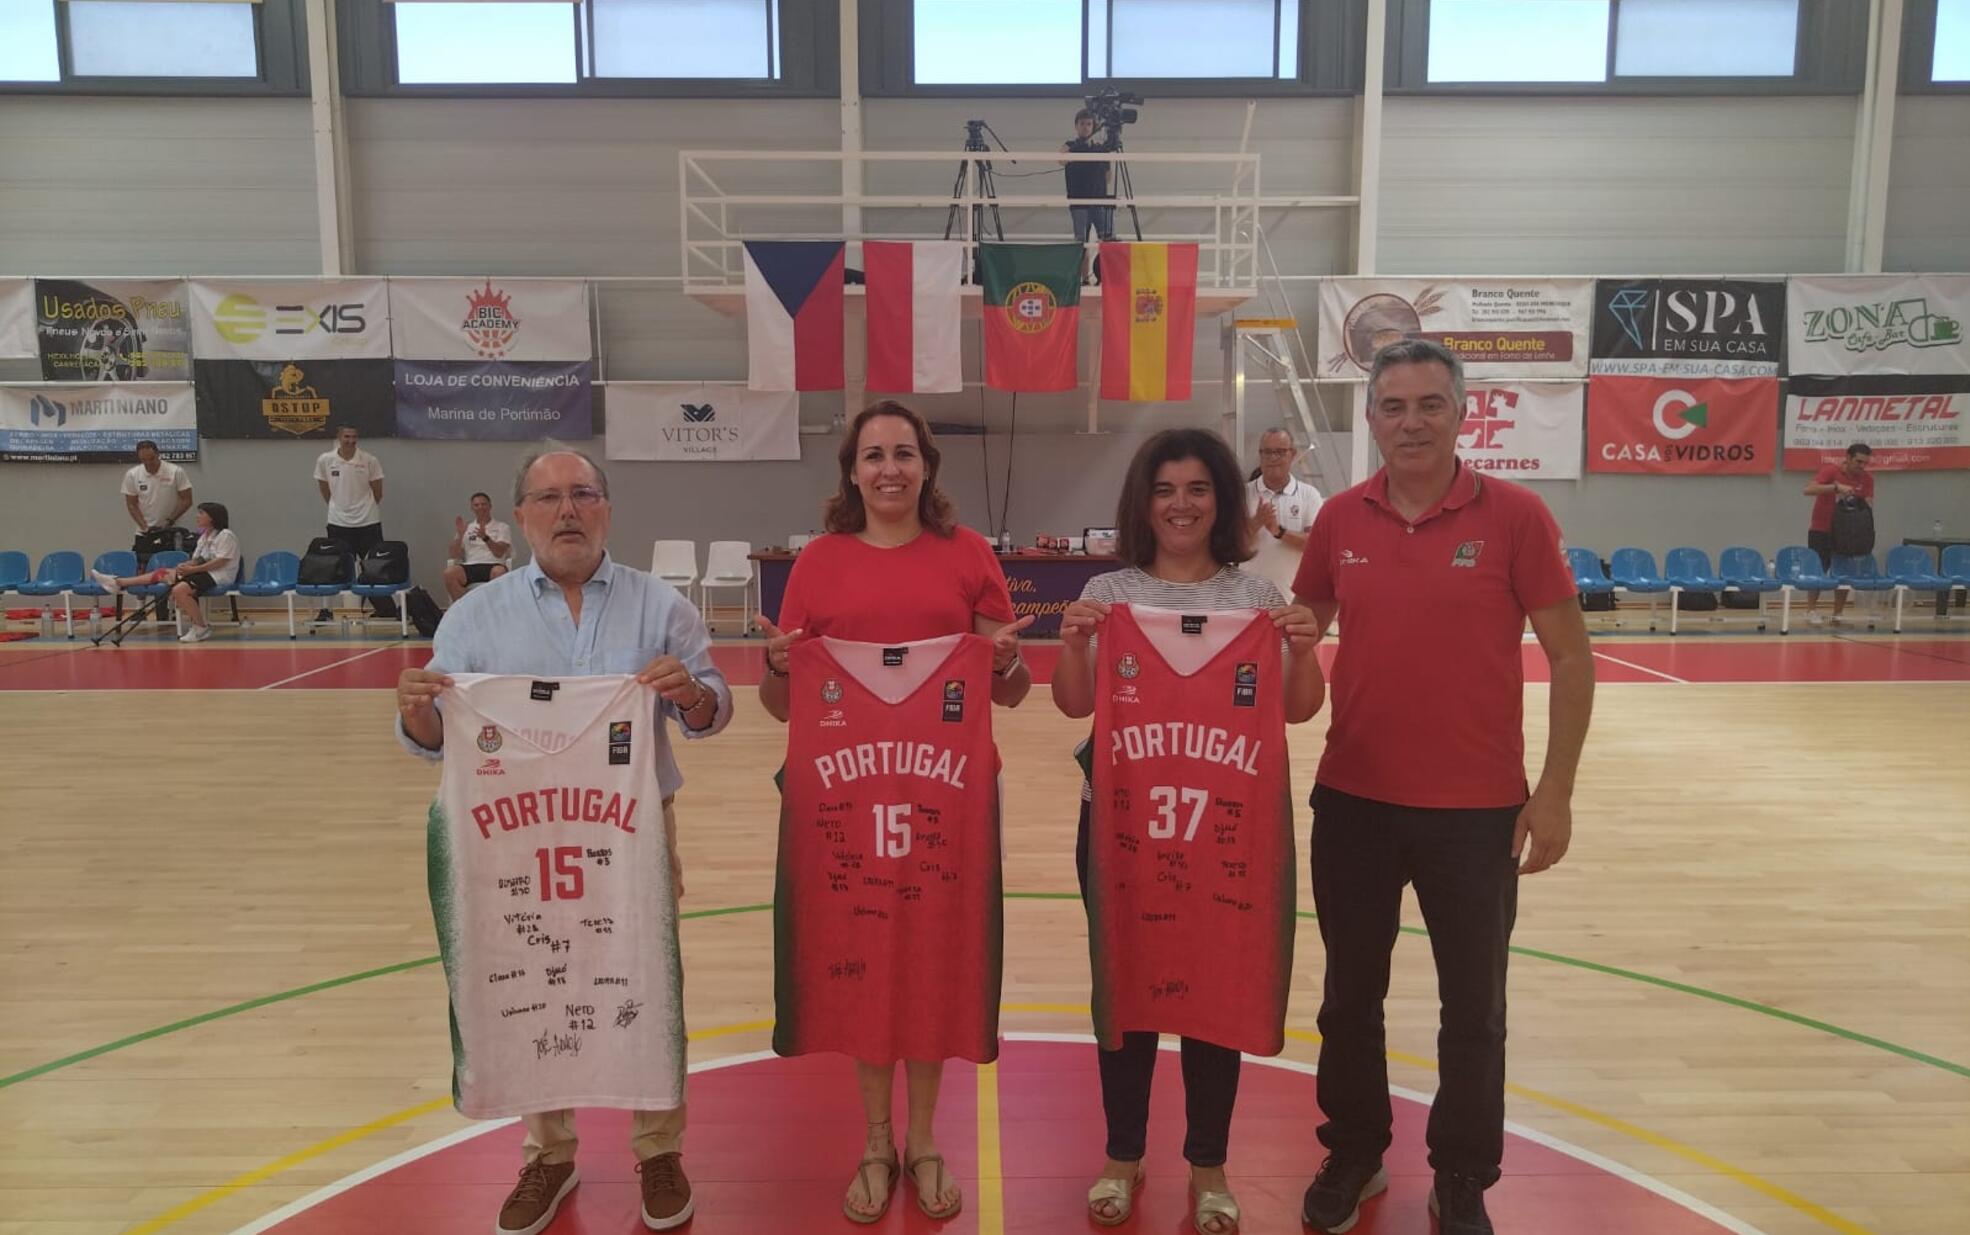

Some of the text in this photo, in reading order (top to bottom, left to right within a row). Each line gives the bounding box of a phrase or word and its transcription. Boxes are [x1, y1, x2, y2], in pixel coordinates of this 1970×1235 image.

[1471, 288, 1541, 300] Branco Quente
[43, 295, 182, 320] Usados Pneu
[1665, 290, 1769, 335] SPA
[275, 303, 367, 334] EXIS
[462, 319, 520, 329] ACADEMY
[1803, 302, 1909, 338] ZONA
[1443, 336, 1547, 352] Branco Quente
[1664, 339, 1767, 354] EM SUA CASA
[404, 373, 444, 386] LOJA
[447, 374, 468, 387] DE
[70, 398, 168, 416] MARTINIANO
[427, 406, 561, 421] Marina de Portimão
[1796, 395, 1961, 421] LANMETAL
[661, 426, 739, 443] VITOR'S
[682, 446, 718, 454] VILLAGE
[1602, 443, 1661, 461] CASA
[1675, 444, 1755, 461] VIDROS
[1462, 458, 1541, 471] ecarnes
[1111, 720, 1263, 777] PORTUGAL
[814, 740, 968, 790] PORTUGAL
[471, 786, 638, 840] PORTUGAL
[1148, 785, 1209, 842] 37
[872, 803, 912, 858] 15
[535, 846, 585, 902] 15
[527, 933, 571, 954] Cris #7
